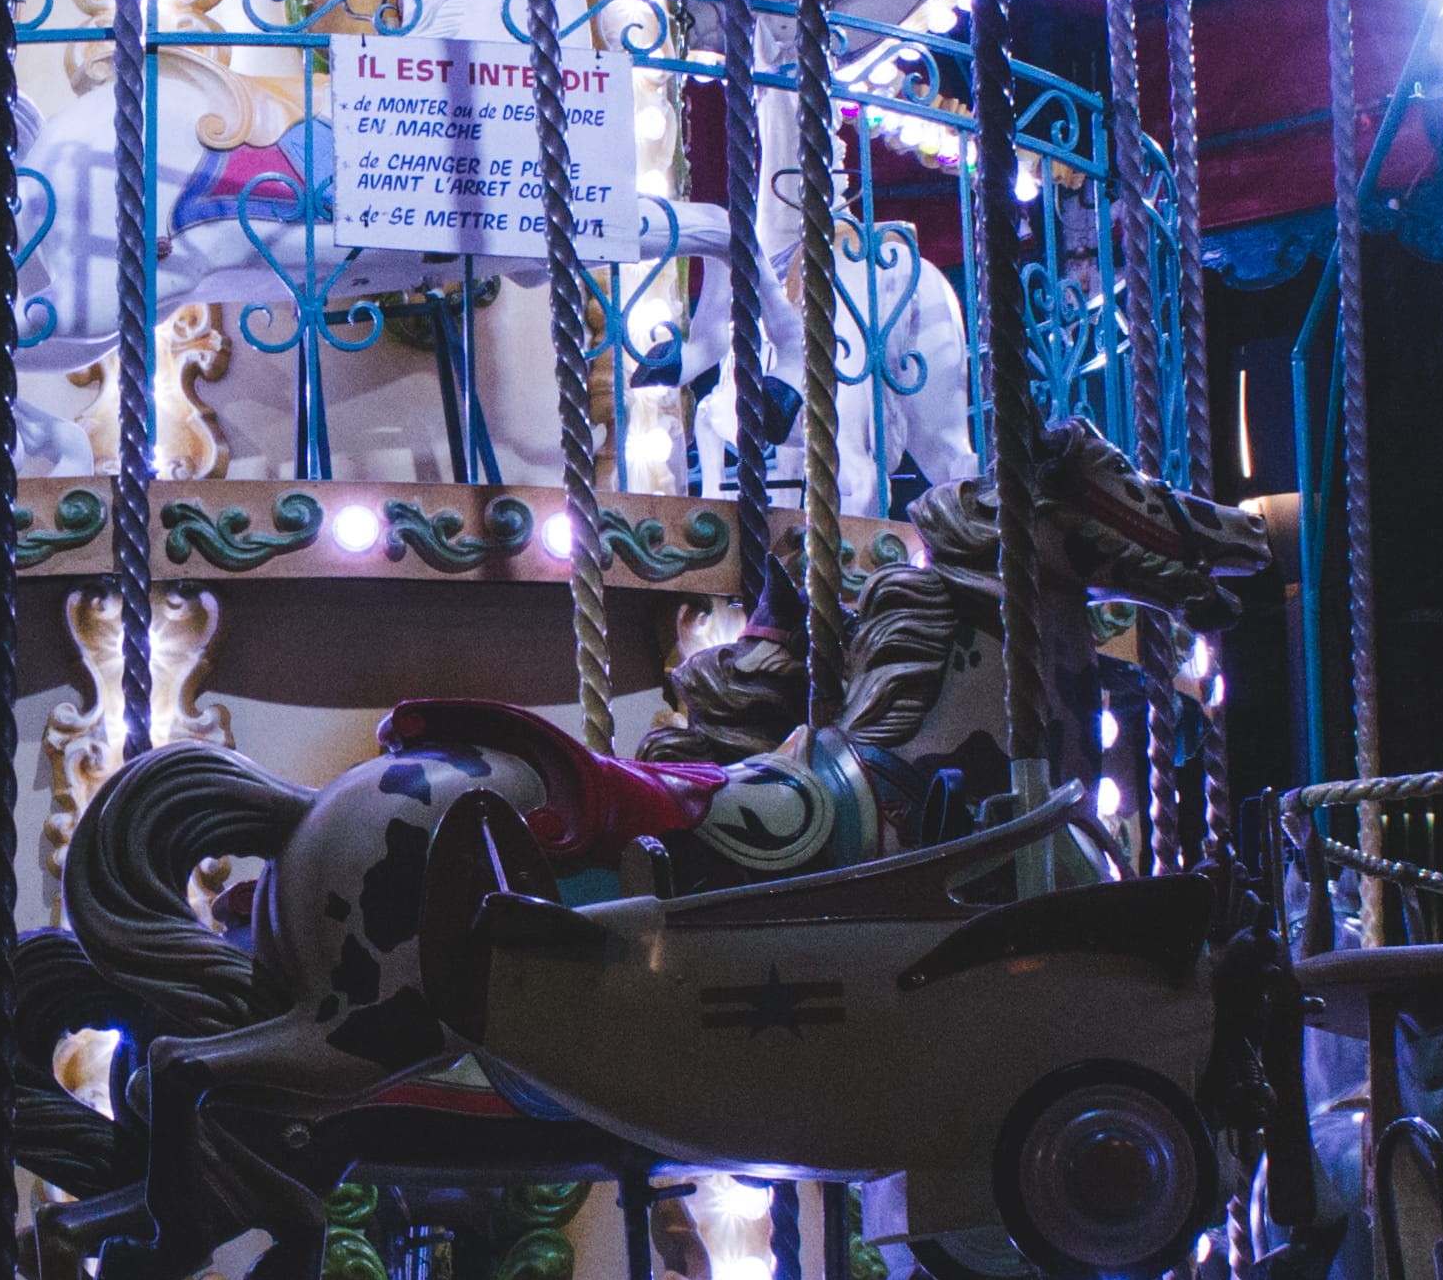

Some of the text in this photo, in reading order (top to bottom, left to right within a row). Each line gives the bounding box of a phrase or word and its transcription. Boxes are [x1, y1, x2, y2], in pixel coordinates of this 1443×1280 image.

[358, 55, 610, 93] IL EST INTEDIT
[353, 95, 372, 112] de
[377, 97, 448, 116] MONTER
[453, 105, 473, 119] ou
[478, 102, 497, 119] de
[357, 117, 482, 140] EN MARCHE
[358, 150, 581, 180] de CHANGER DE PLE
[357, 173, 612, 203] AVANT L'ARRET COLET
[359, 204, 604, 237] de SE METTRE DEUT
